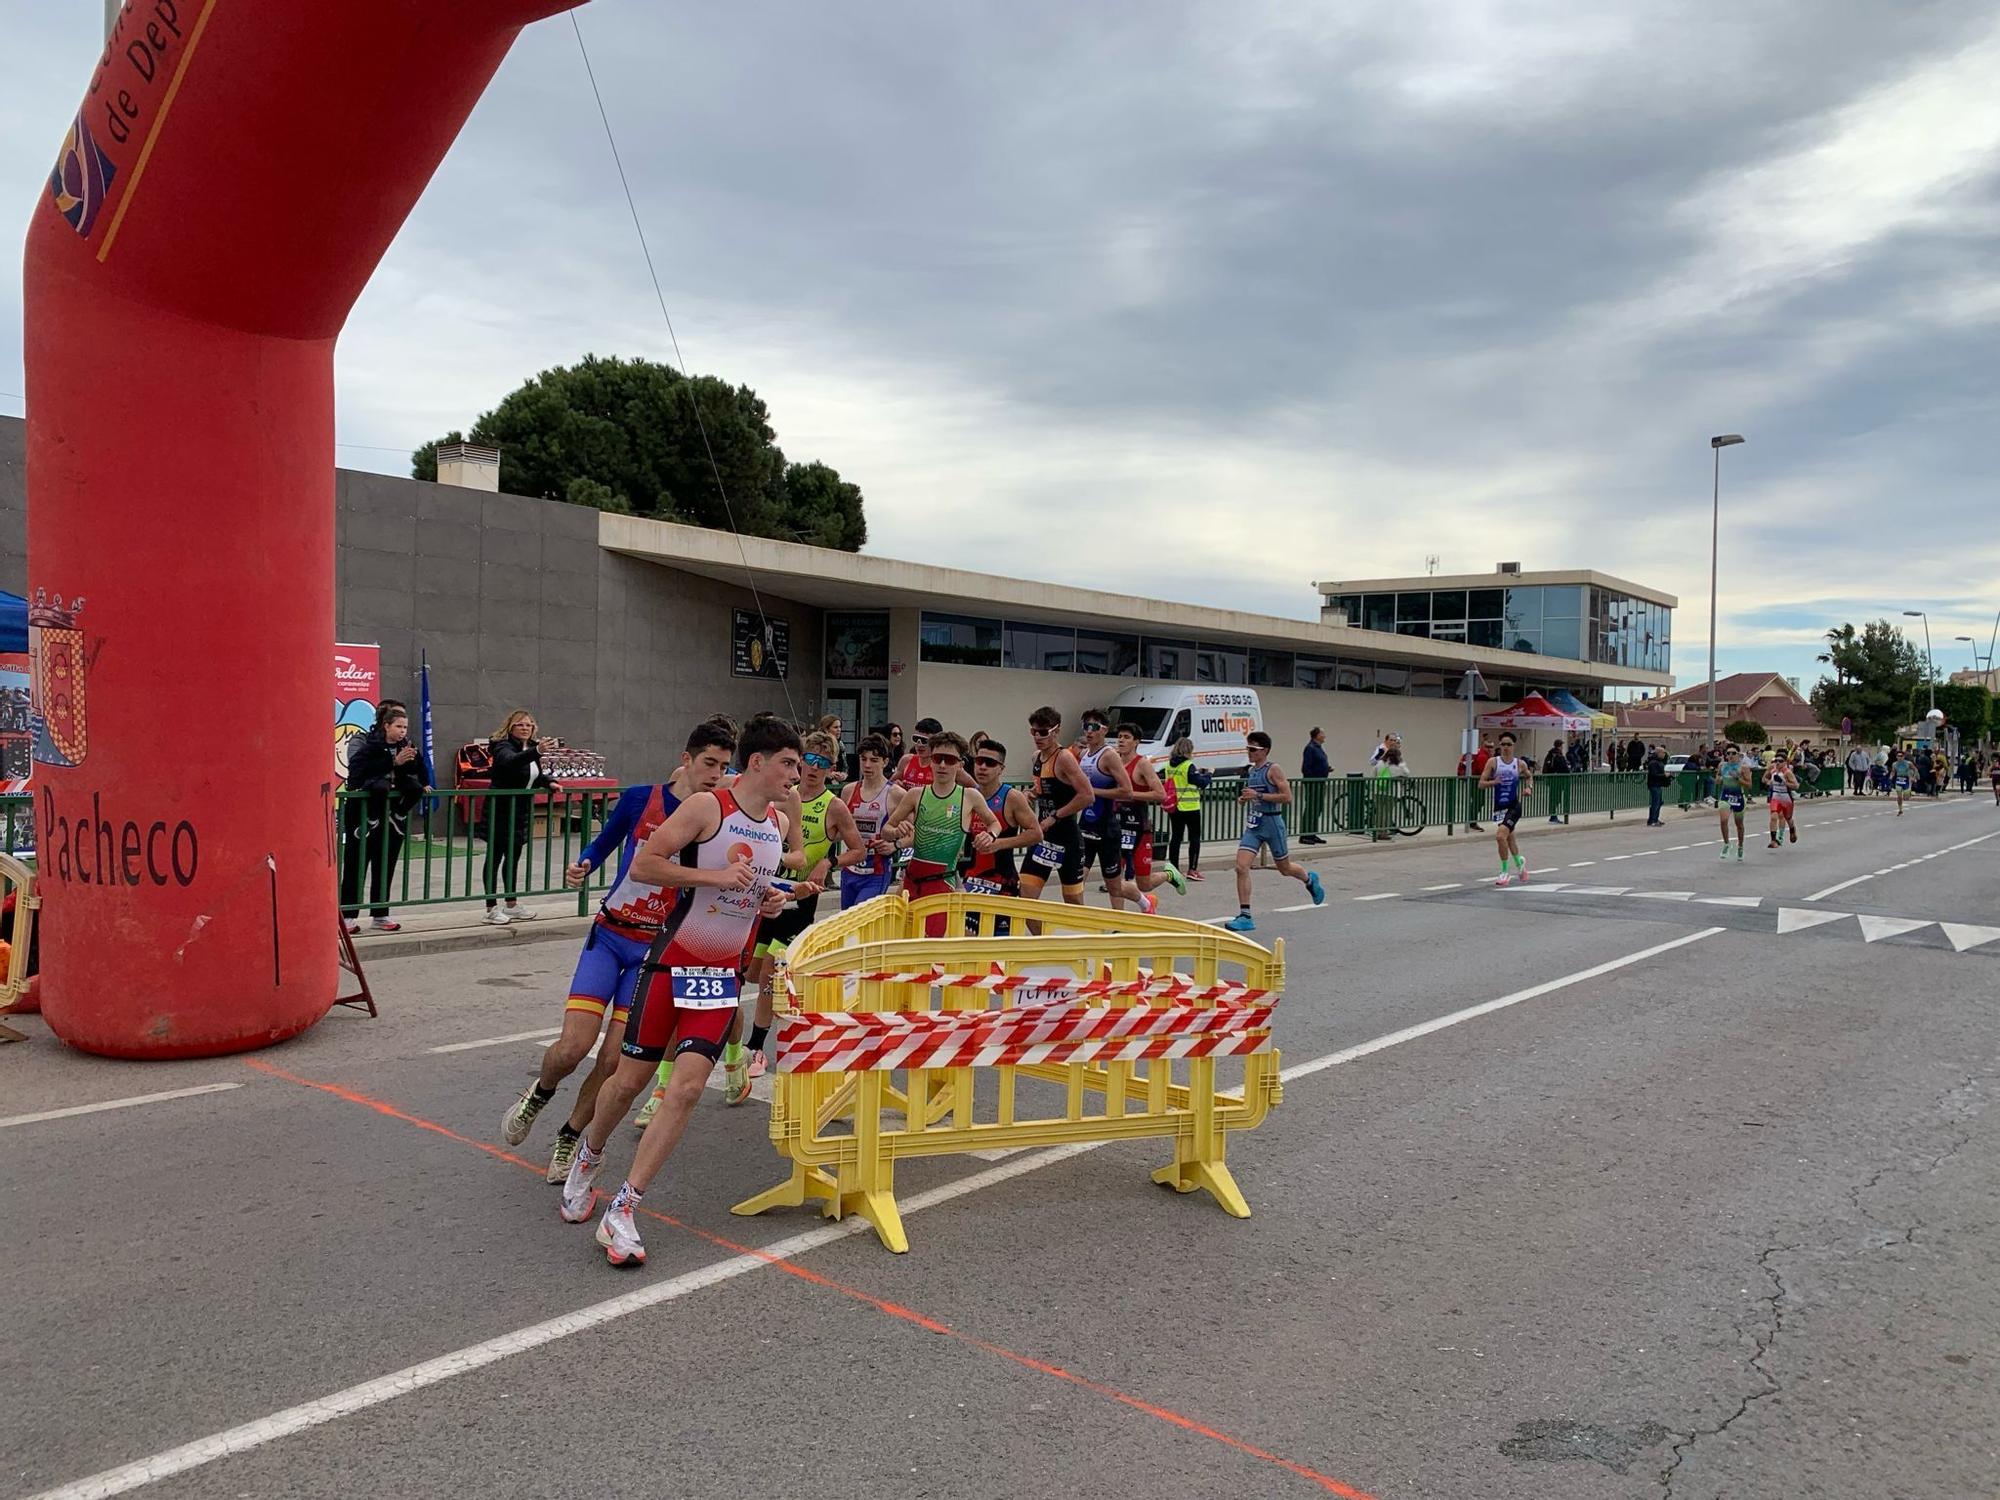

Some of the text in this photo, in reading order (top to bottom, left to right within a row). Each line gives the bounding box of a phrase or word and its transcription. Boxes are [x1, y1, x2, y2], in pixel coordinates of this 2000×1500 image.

[106, 90, 139, 143] de
[1205, 694, 1220, 705] 605
[43, 784, 199, 888] Pacheco
[1040, 847, 1058, 861] 226
[685, 978, 724, 997] 238
